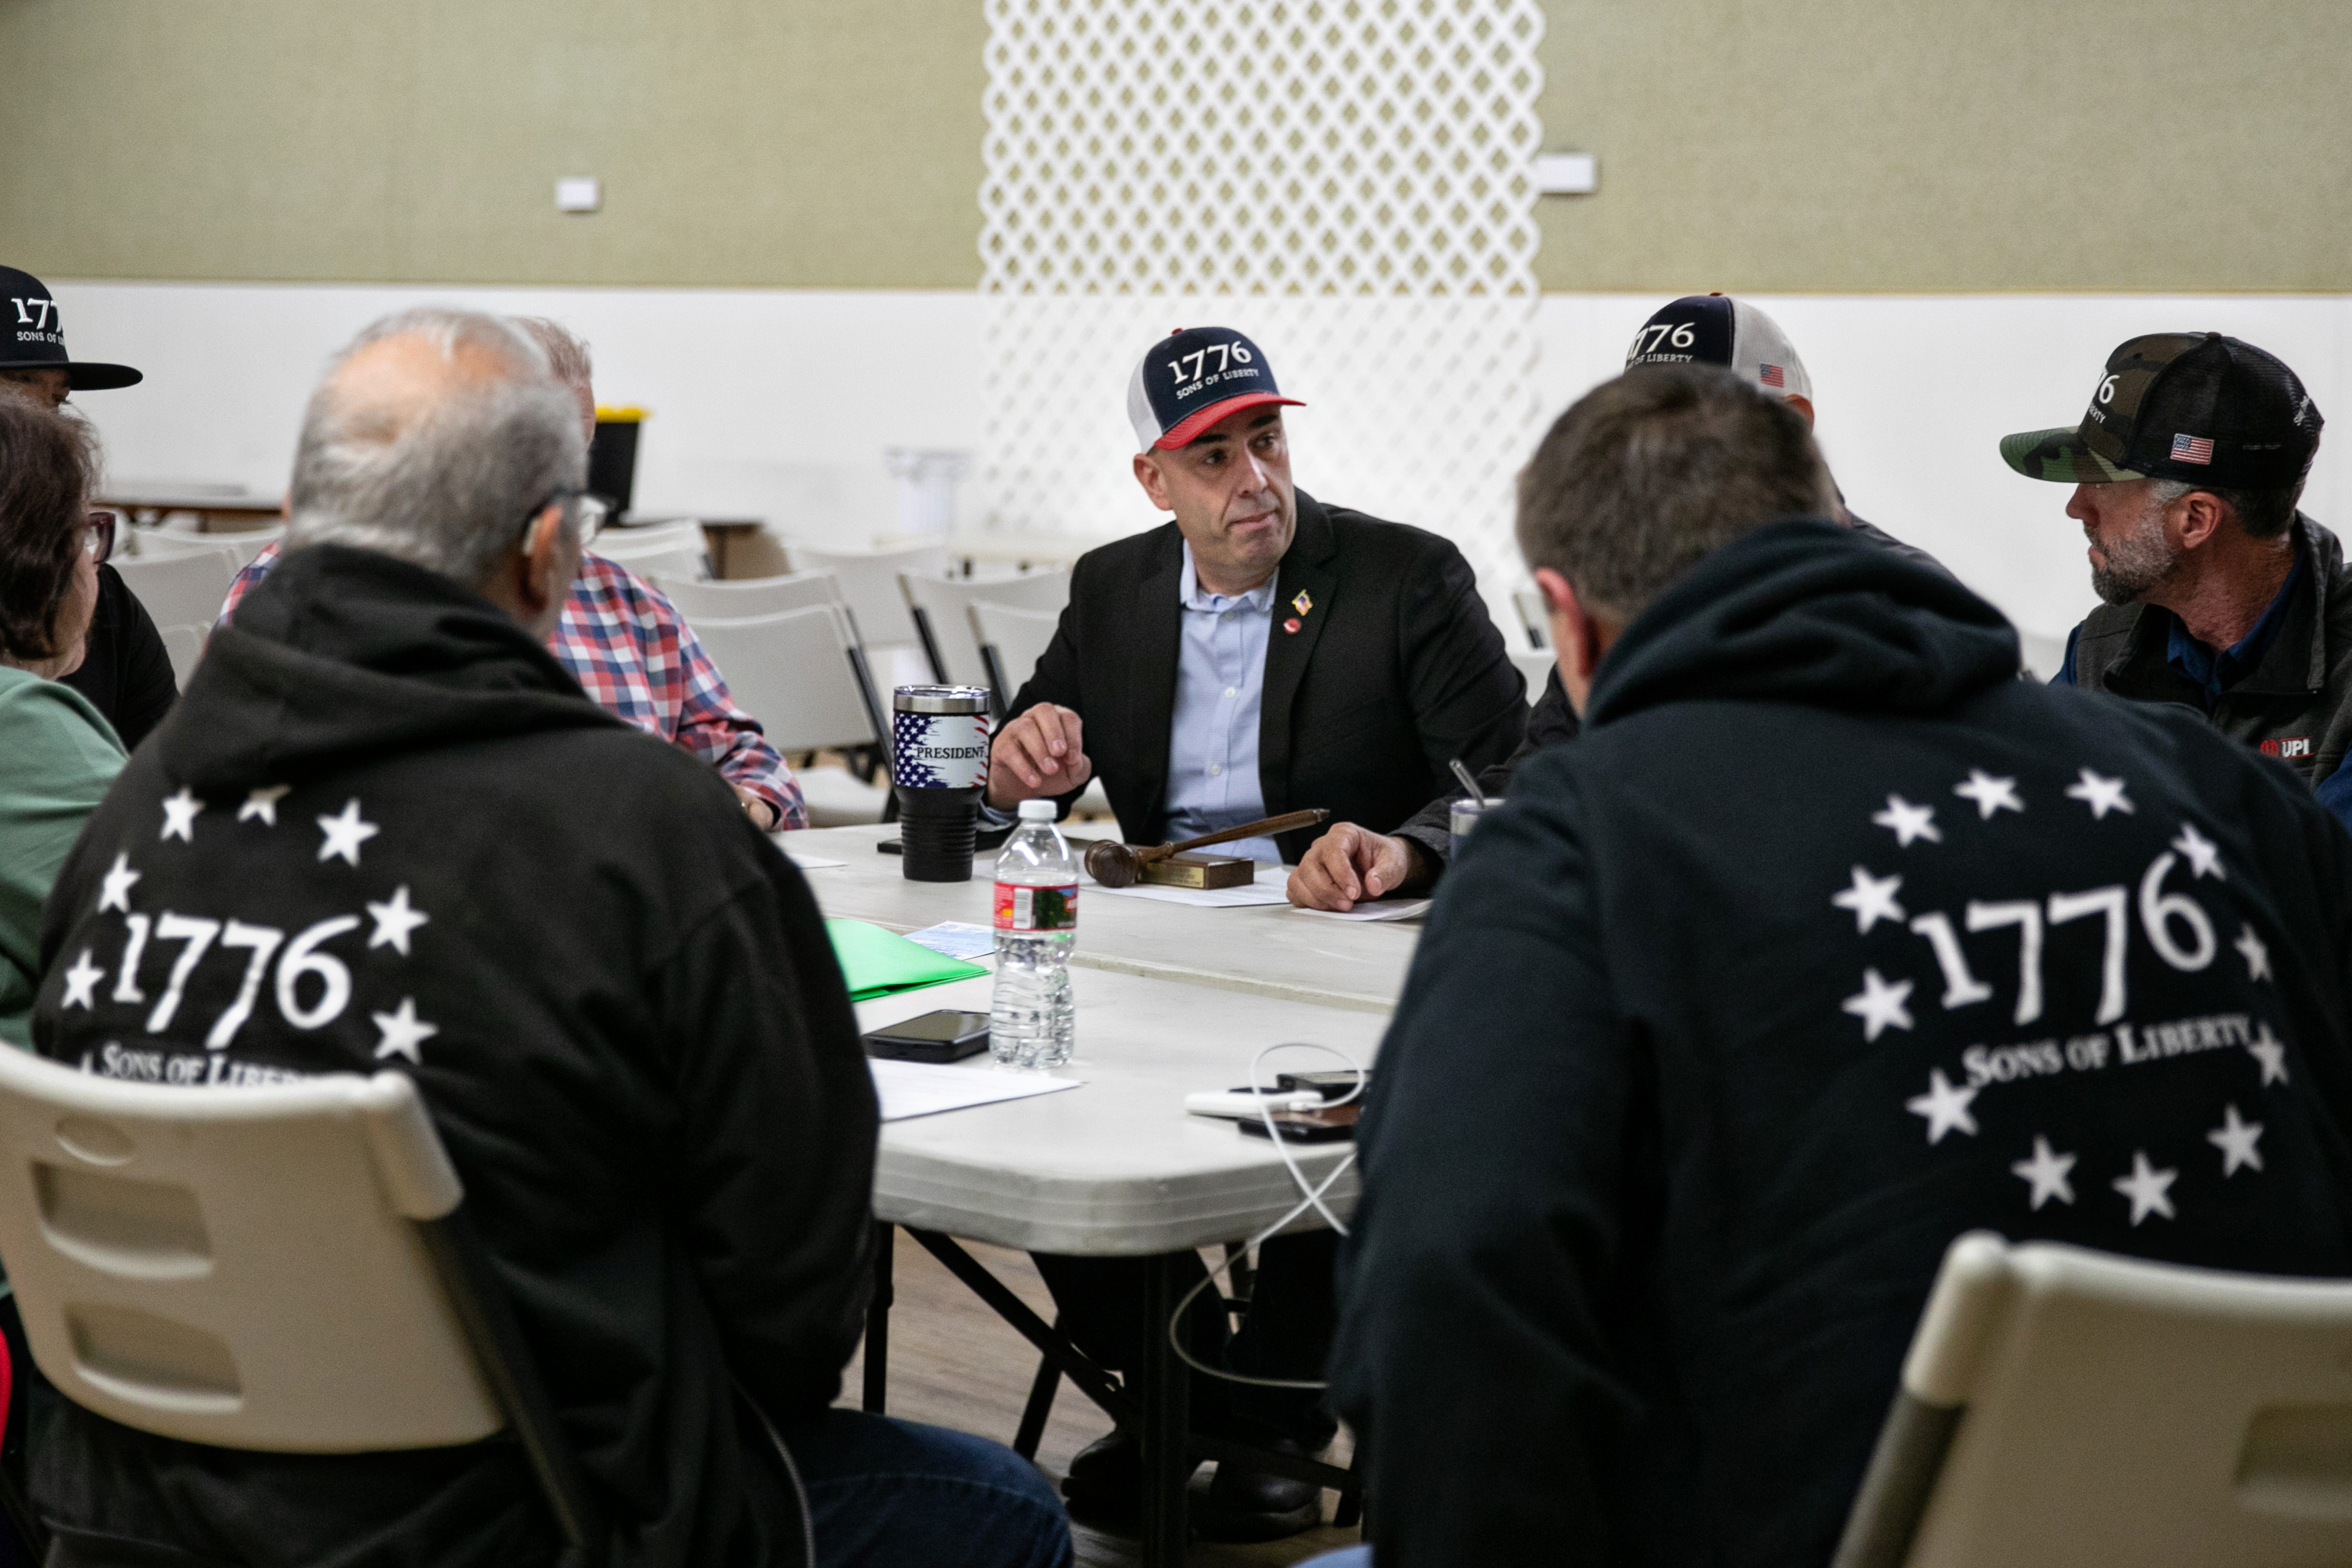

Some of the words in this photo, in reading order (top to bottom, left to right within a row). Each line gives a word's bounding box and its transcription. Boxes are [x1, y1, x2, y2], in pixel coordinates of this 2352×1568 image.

[11, 298, 61, 333] 177
[17, 331, 45, 341] SONS
[47, 333, 57, 344] OF
[1168, 341, 1252, 384] 1776
[1647, 354, 1693, 363] LIBERTY
[1176, 380, 1204, 399] SONS
[1205, 374, 1220, 385] OF
[1222, 369, 1260, 380] LIBERTY
[917, 746, 984, 759] PRESIDENT
[2282, 738, 2310, 757] UPI
[1909, 852, 2217, 1027] 1776
[111, 909, 361, 1050] 1776
[103, 1040, 163, 1081] SONS
[1962, 1037, 2064, 1087] SONS
